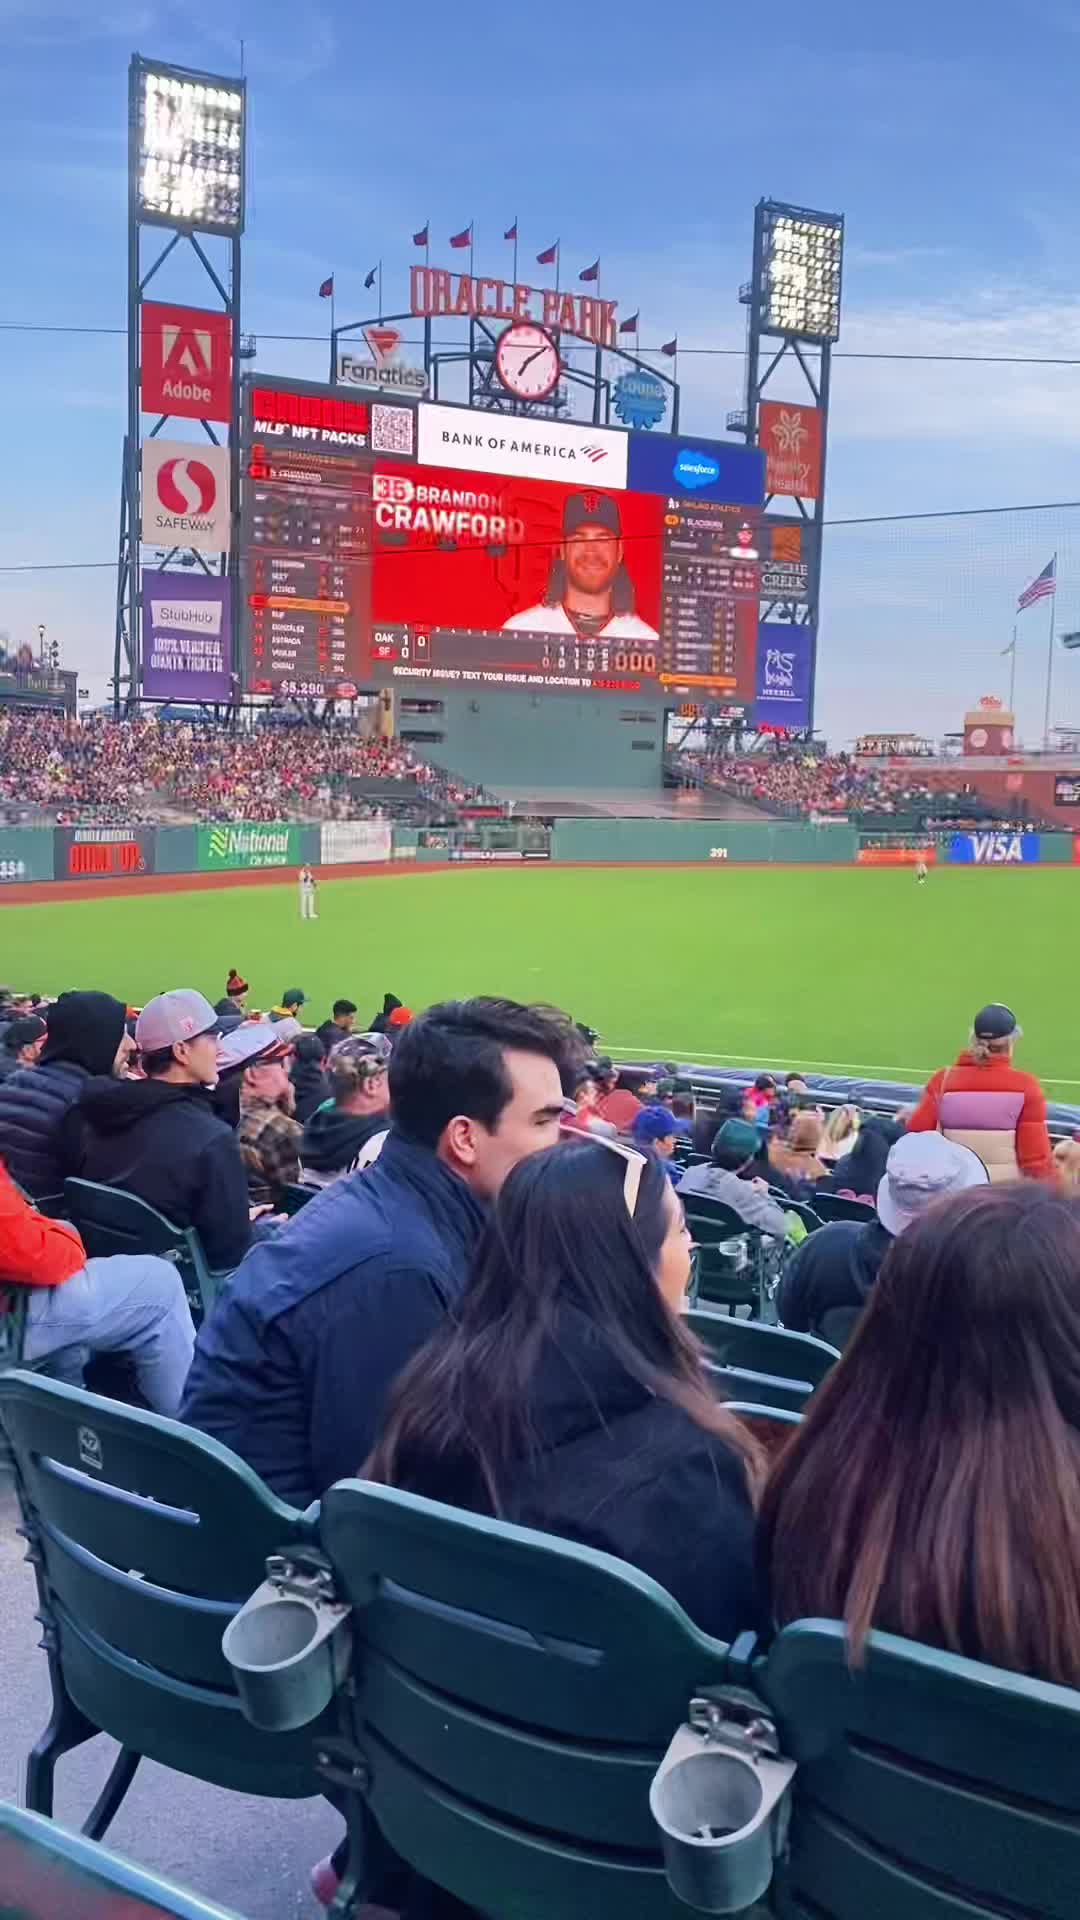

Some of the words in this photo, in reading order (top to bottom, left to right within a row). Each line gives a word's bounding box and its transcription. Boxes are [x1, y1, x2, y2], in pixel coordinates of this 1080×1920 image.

[410, 265, 531, 318] ORACLE
[543, 289, 618, 344] PARK
[341, 356, 426, 387] Fanatics
[162, 379, 212, 402] Adobe
[292, 427, 318, 441] NFT
[321, 431, 366, 446] PACKS
[442, 431, 483, 447] BANK
[488, 437, 506, 450] OF
[510, 441, 577, 459] AMERICA
[679, 464, 716, 475] salesforce
[156, 515, 216, 531] SAFEWAY
[375, 502, 525, 542] CRAWFORD
[160, 607, 213, 624] StubHub
[375, 632, 394, 643] OAK
[379, 646, 391, 656] SF
[393, 666, 432, 678] SECURITY
[432, 669, 460, 679] ISSUE?
[462, 670, 481, 680] TEXT
[483, 671, 504, 681] YOUR
[504, 673, 526, 683] ISSUE
[528, 674, 544, 683] AND
[545, 676, 580, 686] LOCATION
[582, 678, 592, 687] TO
[229, 829, 289, 853] National
[969, 834, 1024, 862] VISA
